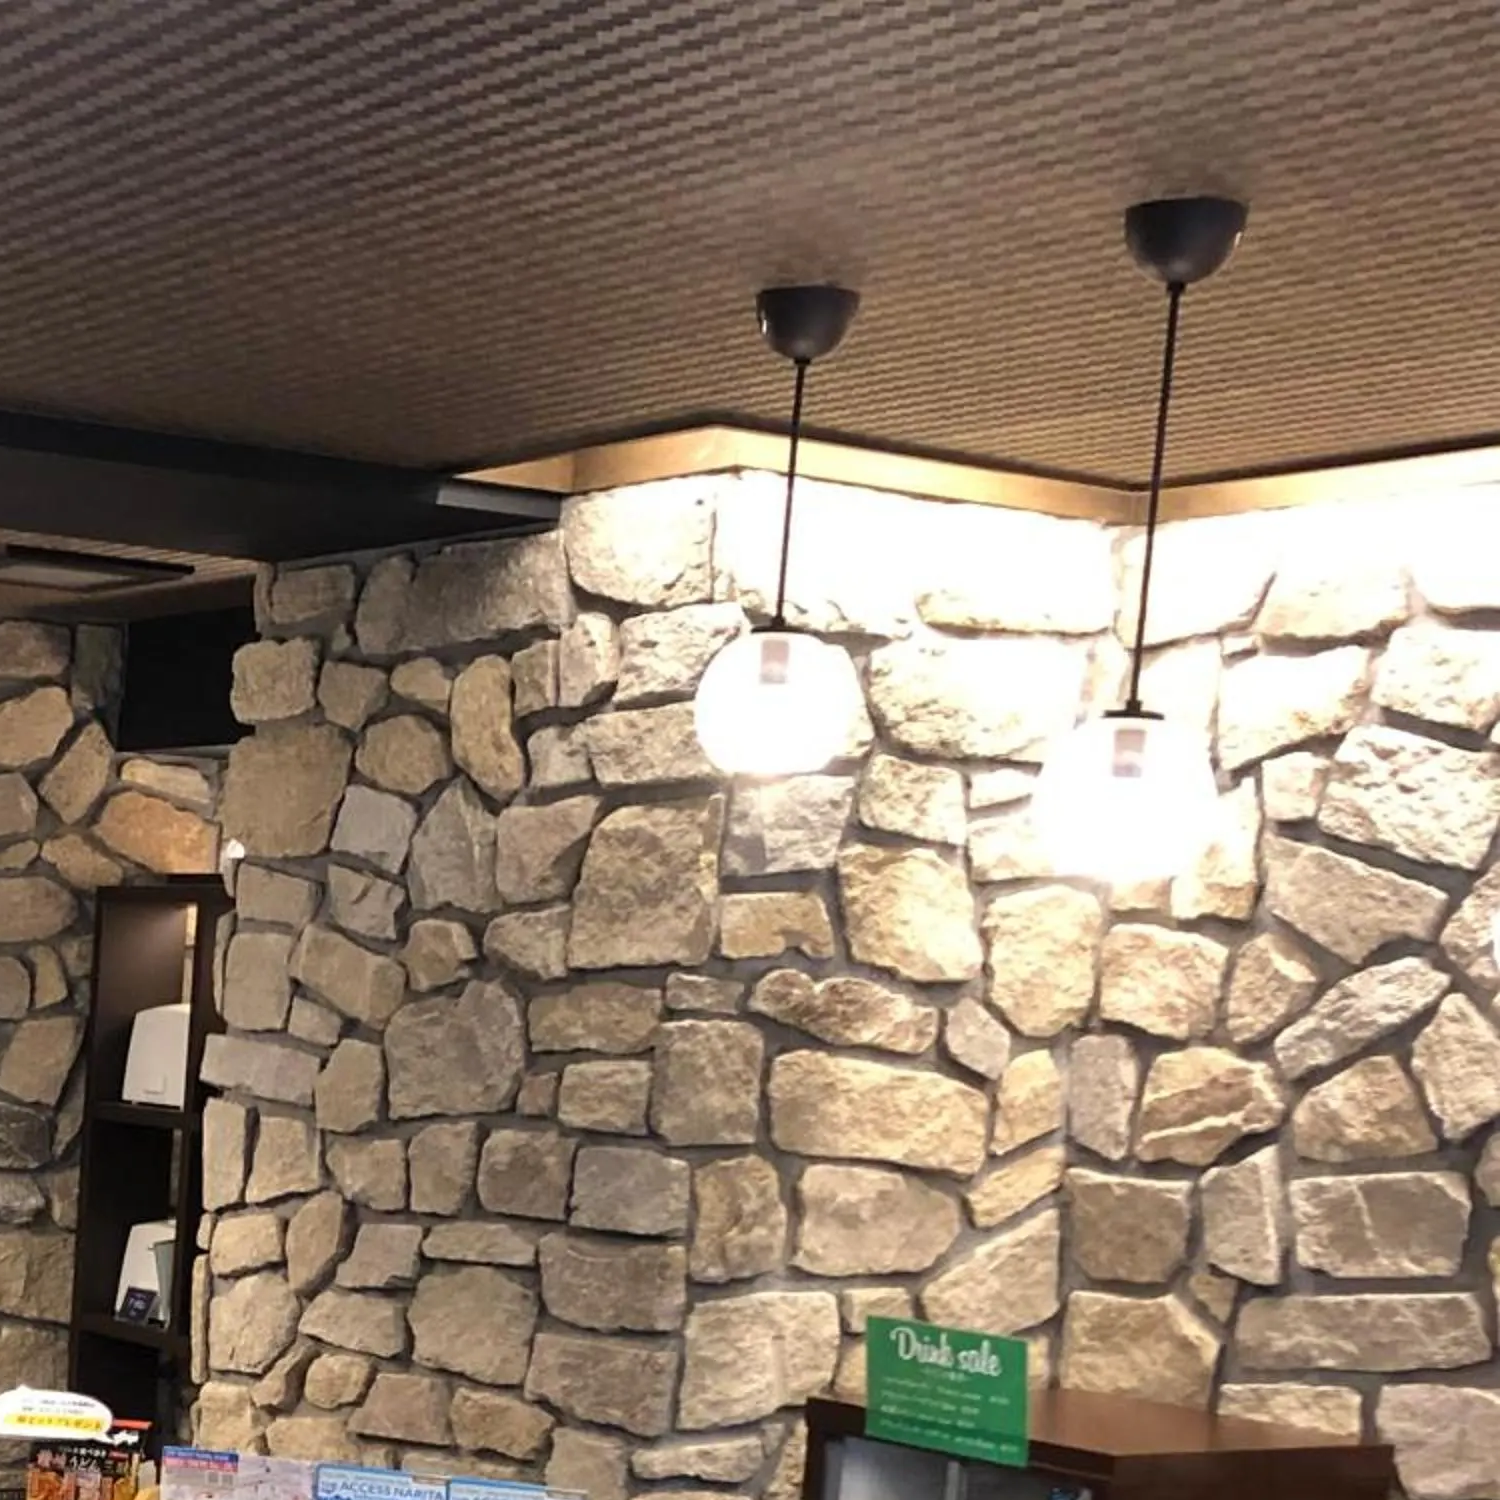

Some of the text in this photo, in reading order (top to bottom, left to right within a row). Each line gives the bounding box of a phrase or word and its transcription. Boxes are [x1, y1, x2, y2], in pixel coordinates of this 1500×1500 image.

[890, 1327, 954, 1368] Drink
[958, 1340, 1002, 1377] sale
[340, 1481, 445, 1500] ACCESS NARITA
